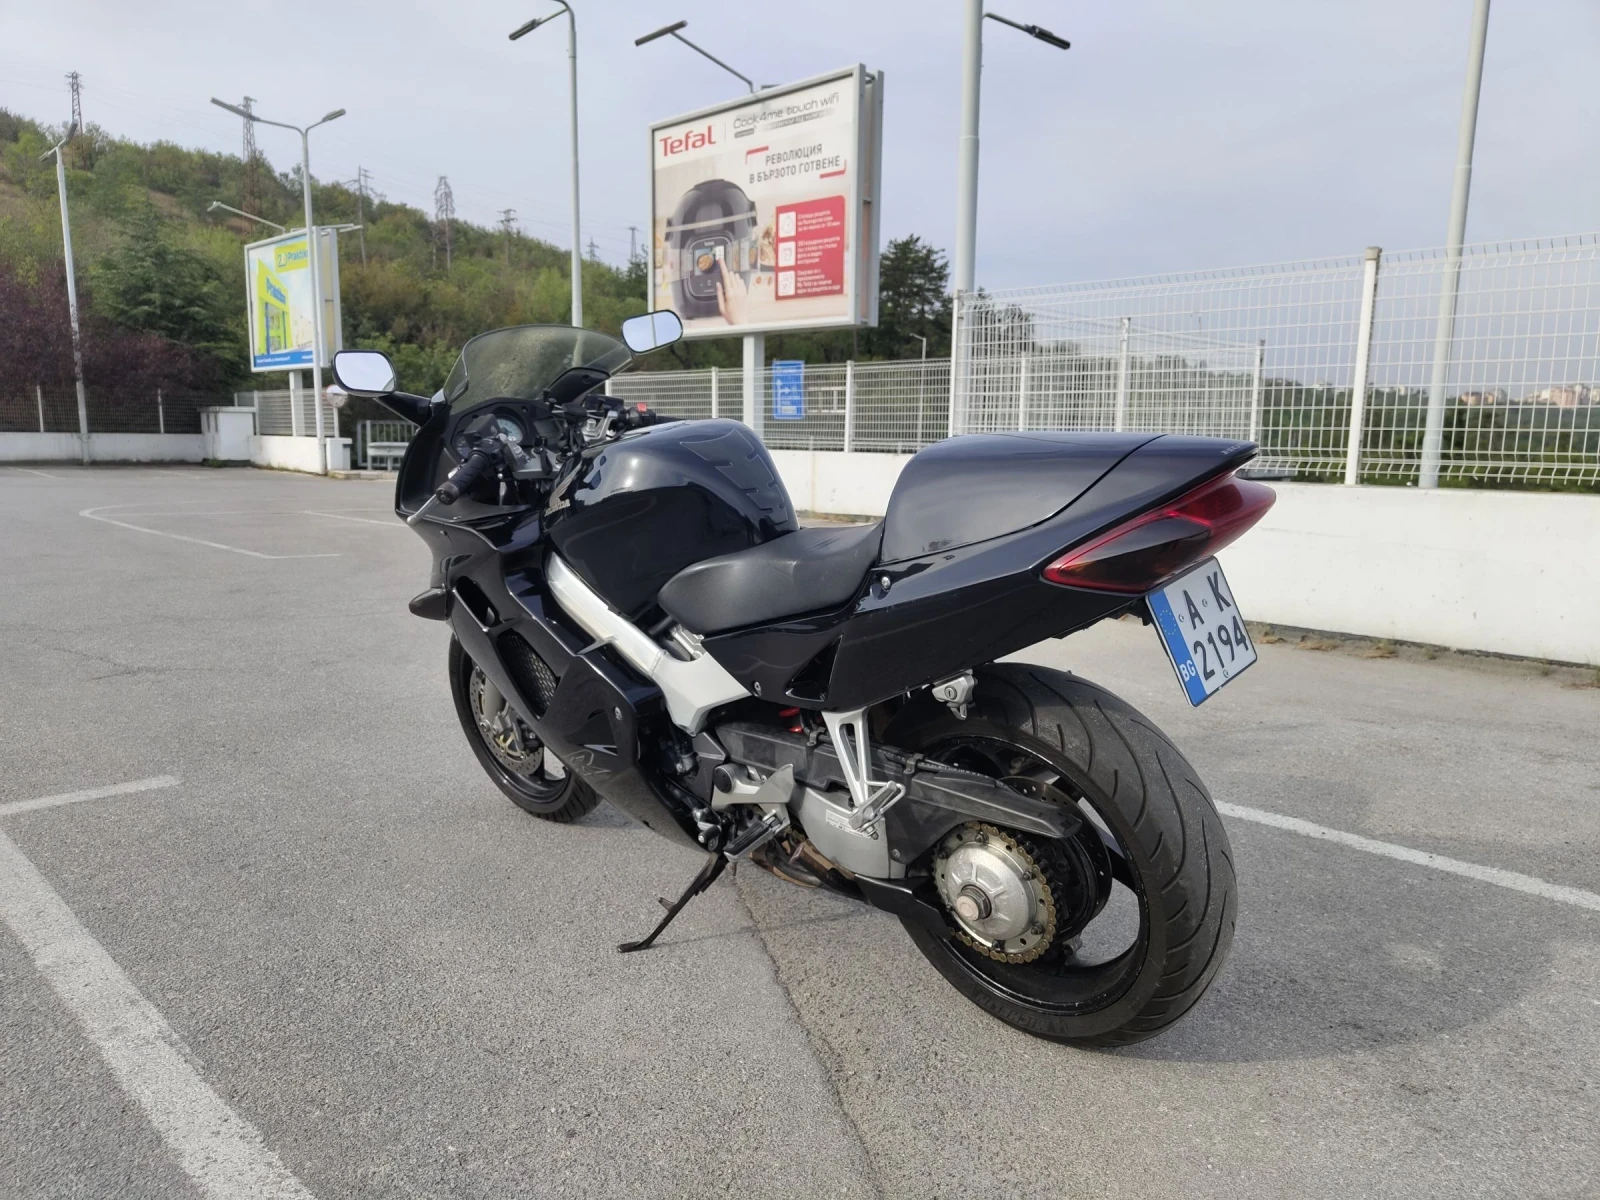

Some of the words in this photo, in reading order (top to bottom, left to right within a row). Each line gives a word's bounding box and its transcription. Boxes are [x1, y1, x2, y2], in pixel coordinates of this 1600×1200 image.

[733, 106, 783, 130] Cook4me
[787, 98, 819, 115] touch
[821, 92, 840, 107] wifi
[660, 125, 717, 157] Tefal
[765, 143, 823, 166] РЕВОЛЮЦИЯ
[749, 173, 756, 184] В
[757, 166, 797, 183] БЪРЗОТО
[799, 155, 841, 174] ГОТВЕНЕ
[1182, 588, 1205, 631] A
[1206, 571, 1232, 613] K
[1193, 615, 1250, 681] 2194
[1179, 659, 1197, 682] BG
